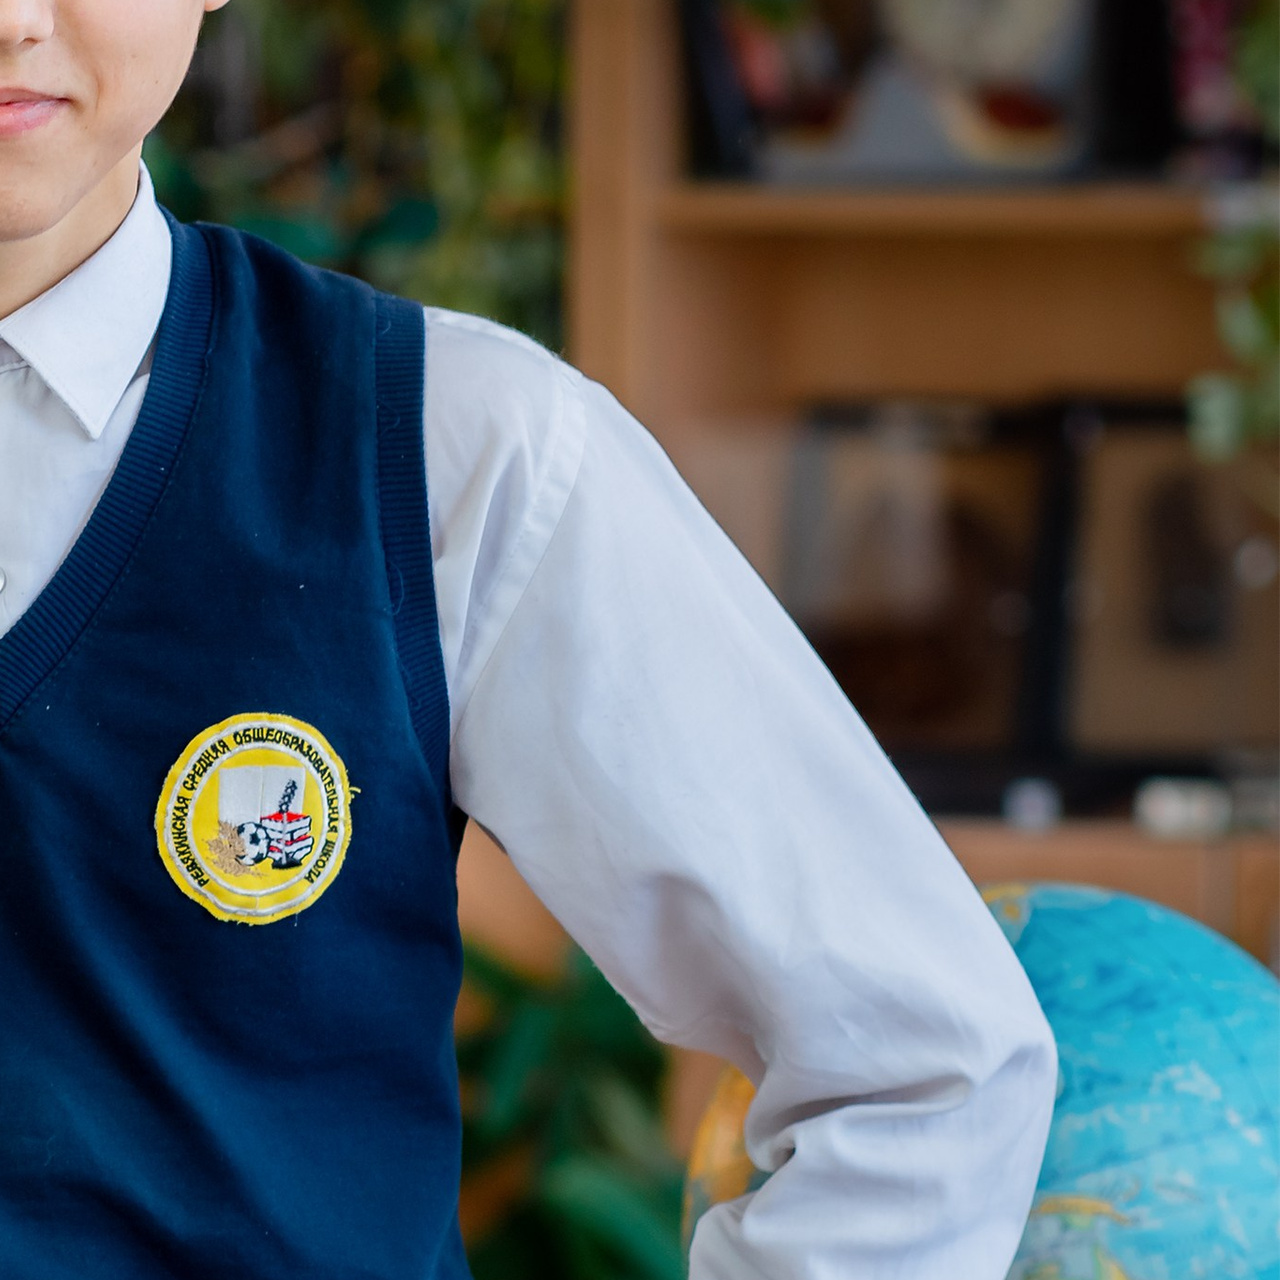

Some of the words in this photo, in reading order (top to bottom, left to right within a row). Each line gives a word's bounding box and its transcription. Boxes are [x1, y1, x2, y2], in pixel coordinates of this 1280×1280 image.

[183, 738, 232, 791] СРЕДНЯЯ
[233, 727, 339, 834] ОБЩЕОБРАЗОВАТЕЛЬНАЯ
[172, 795, 210, 887] РЕВЯКИНСКАЯ
[304, 841, 334, 884] ШКОЛА
